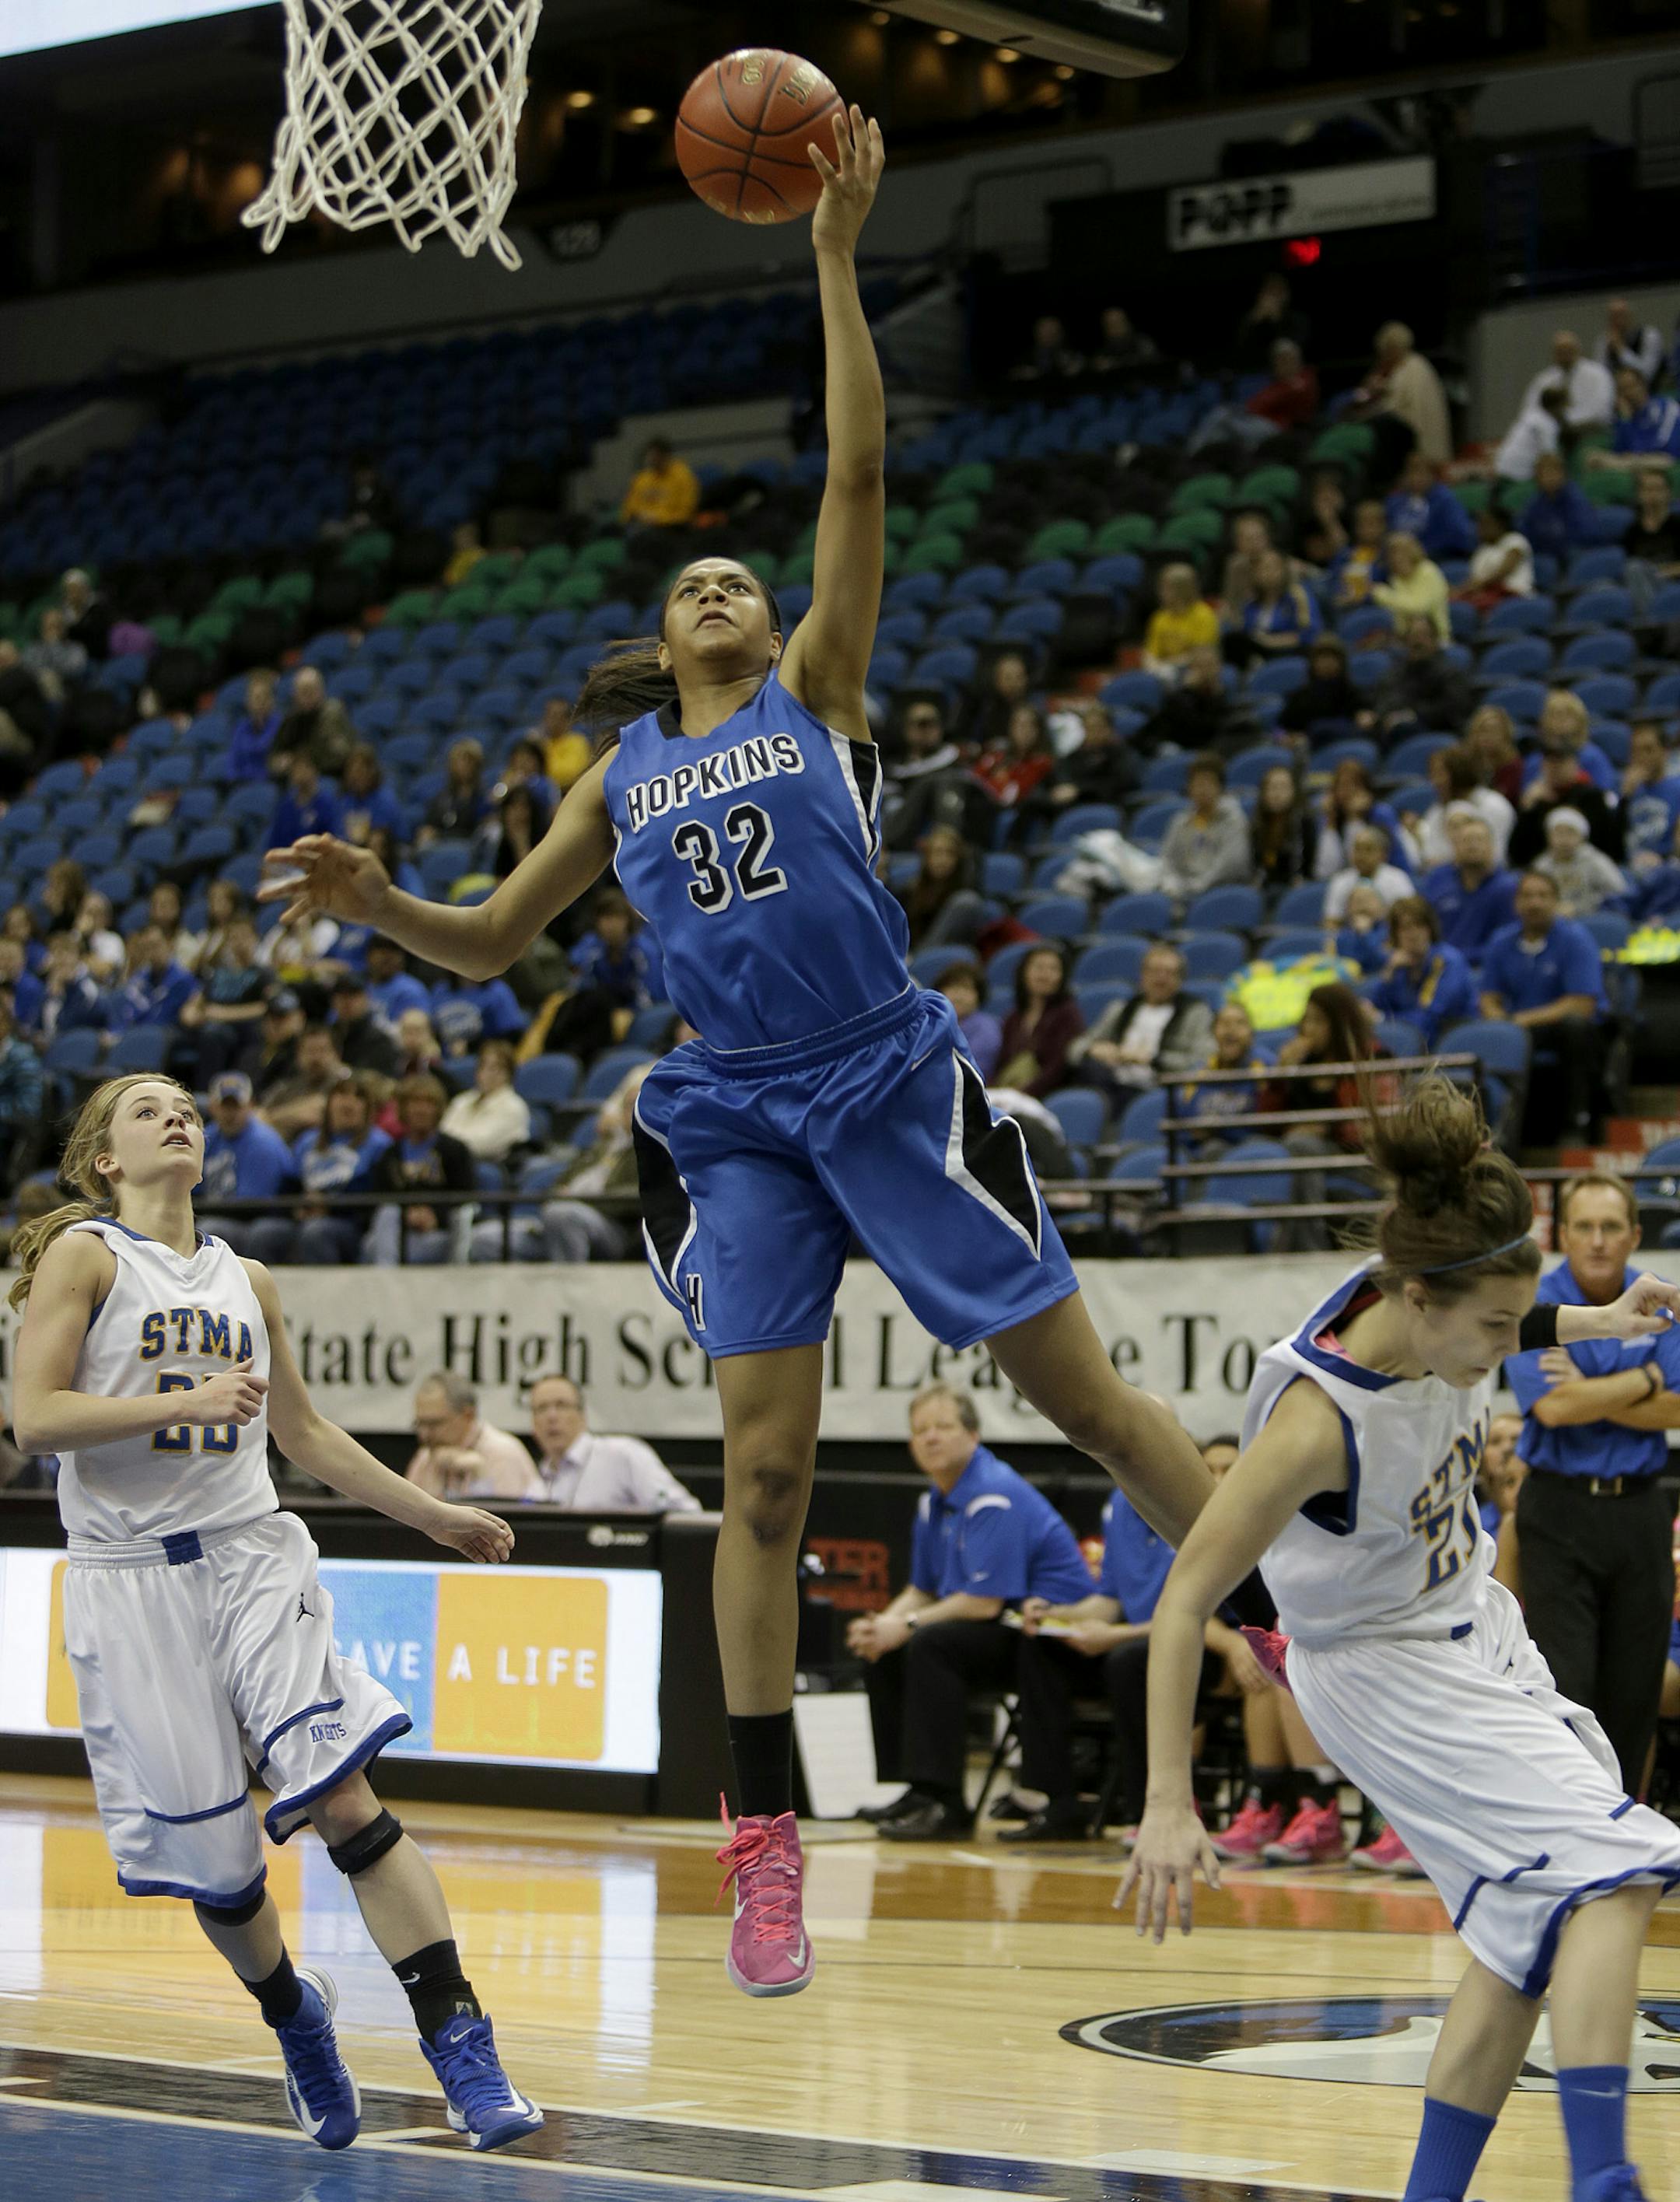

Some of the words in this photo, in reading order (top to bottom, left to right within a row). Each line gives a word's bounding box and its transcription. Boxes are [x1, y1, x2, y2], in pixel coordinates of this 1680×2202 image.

[626, 733, 806, 834] HOPKINS
[672, 801, 789, 915] 32
[139, 1307, 254, 1363] STMA
[285, 1316, 415, 1388] tate
[441, 1312, 589, 1405] High
[1411, 1406, 1491, 1534] STM
[446, 1643, 474, 1683] A
[495, 1645, 598, 1689] LIFE
